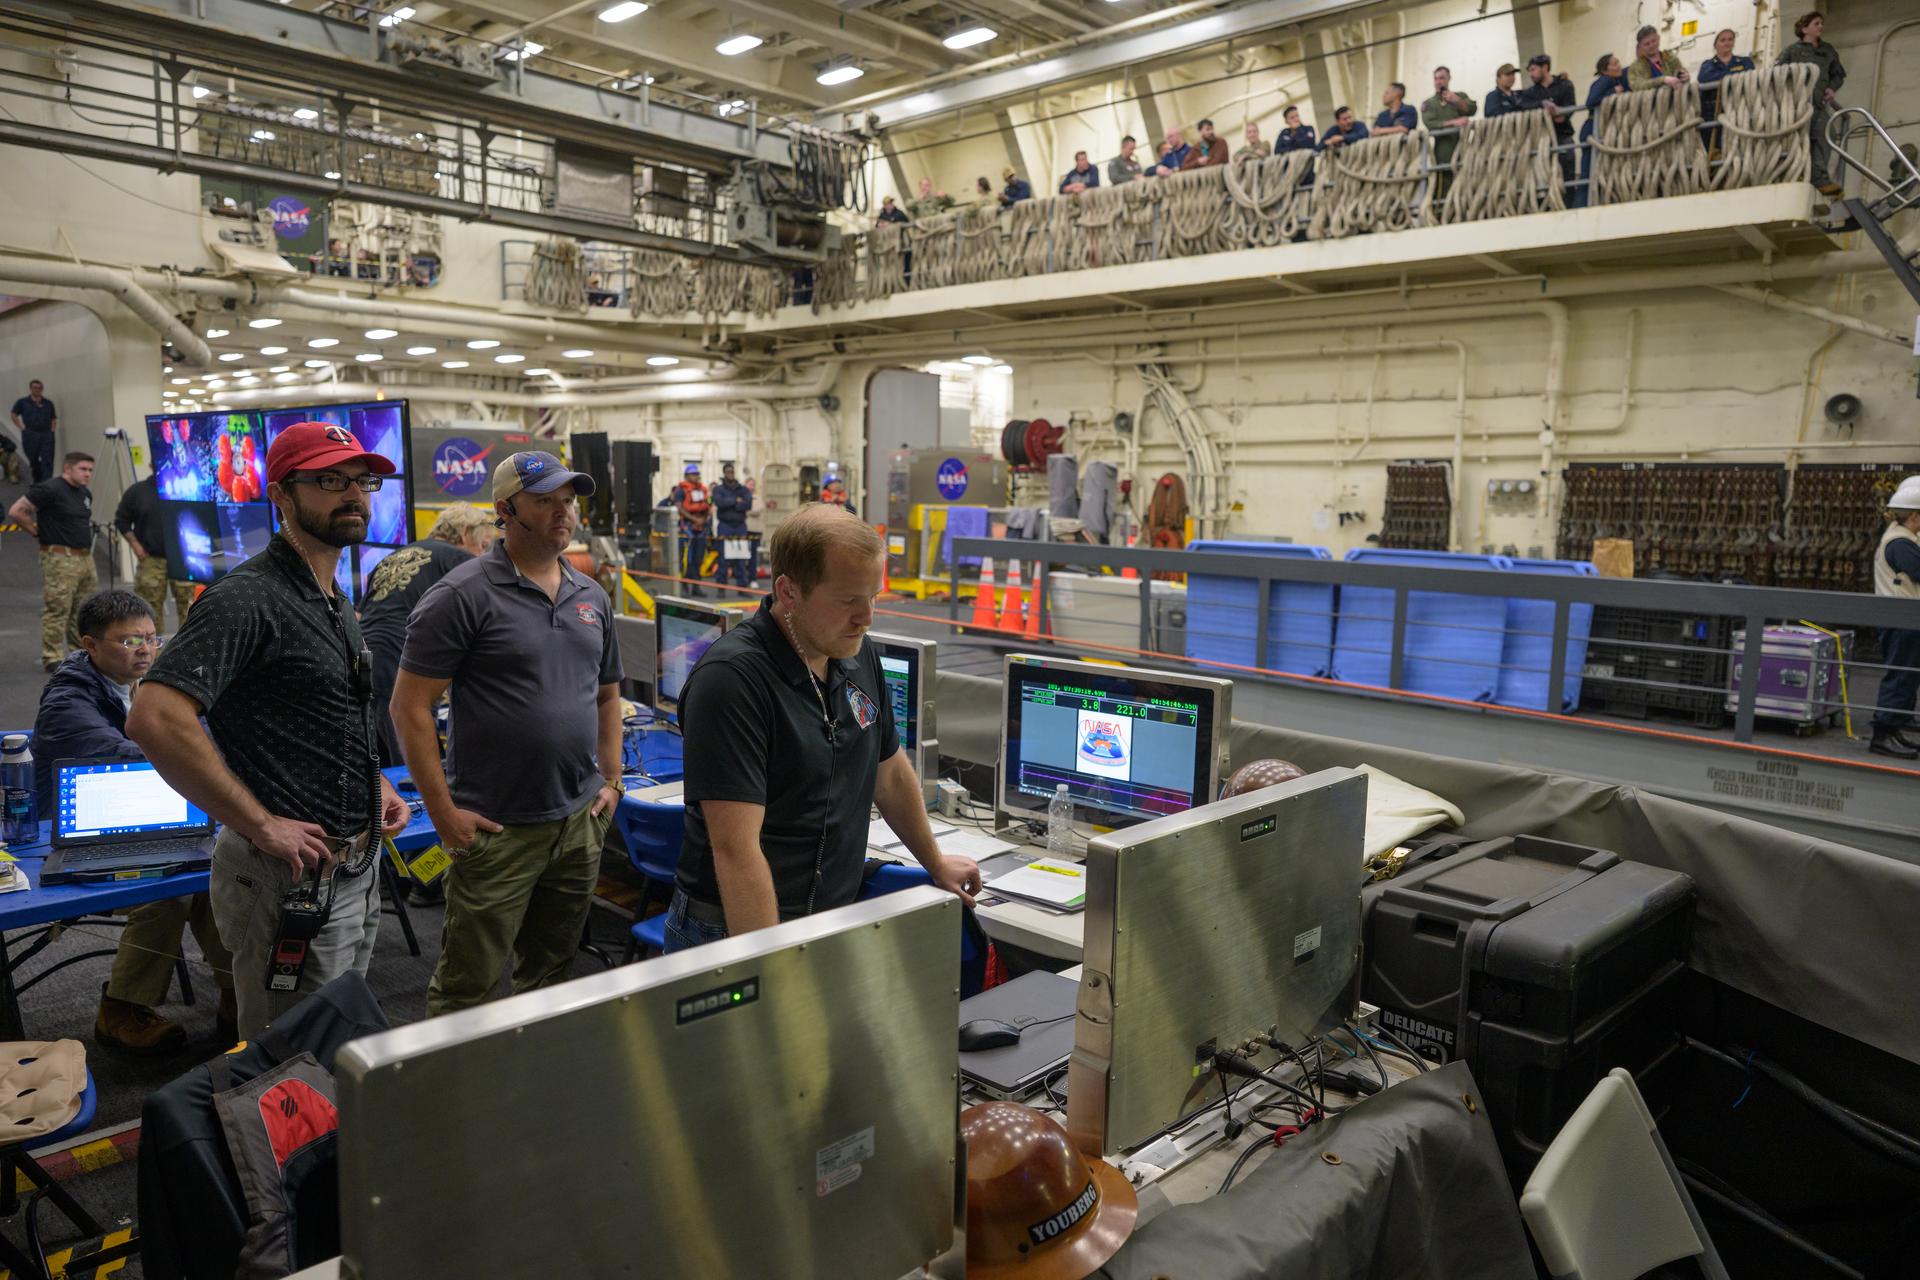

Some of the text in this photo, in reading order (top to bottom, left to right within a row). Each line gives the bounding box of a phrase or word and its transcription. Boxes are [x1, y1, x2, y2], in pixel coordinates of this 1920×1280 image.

[436, 460, 487, 474] NASA
[939, 474, 966, 485] NASA
[1082, 699, 1099, 710] 3.8
[1116, 704, 1146, 717] 221.0
[1084, 719, 1122, 736] NASA
[1189, 715, 1196, 725] 7
[1756, 760, 1799, 777] CAUTION
[1707, 766, 1855, 799] VEHICLES TRANSITING THIS RAMP SHALL NOT
[1713, 780, 1739, 795] EXCEED
[1383, 1010, 1454, 1045] DELICATE
[1032, 1184, 1097, 1241] YOUBERG
